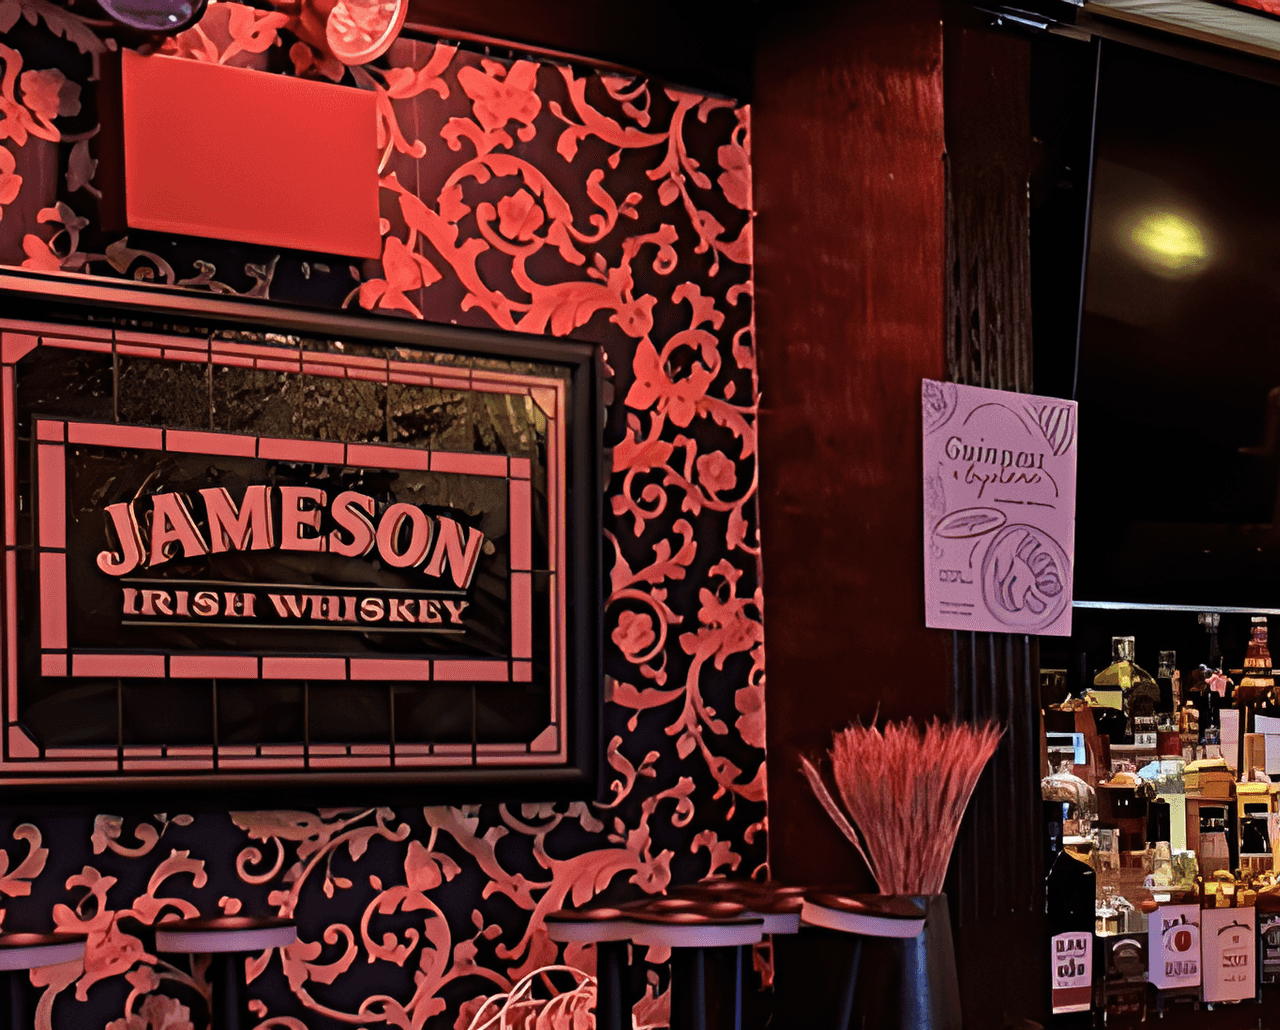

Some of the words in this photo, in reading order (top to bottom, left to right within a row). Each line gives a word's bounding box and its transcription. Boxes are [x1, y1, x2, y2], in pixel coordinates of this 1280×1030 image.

[96, 484, 484, 590] JAMESON
[122, 587, 257, 618] IRISH
[267, 592, 471, 625] WHISKEY
